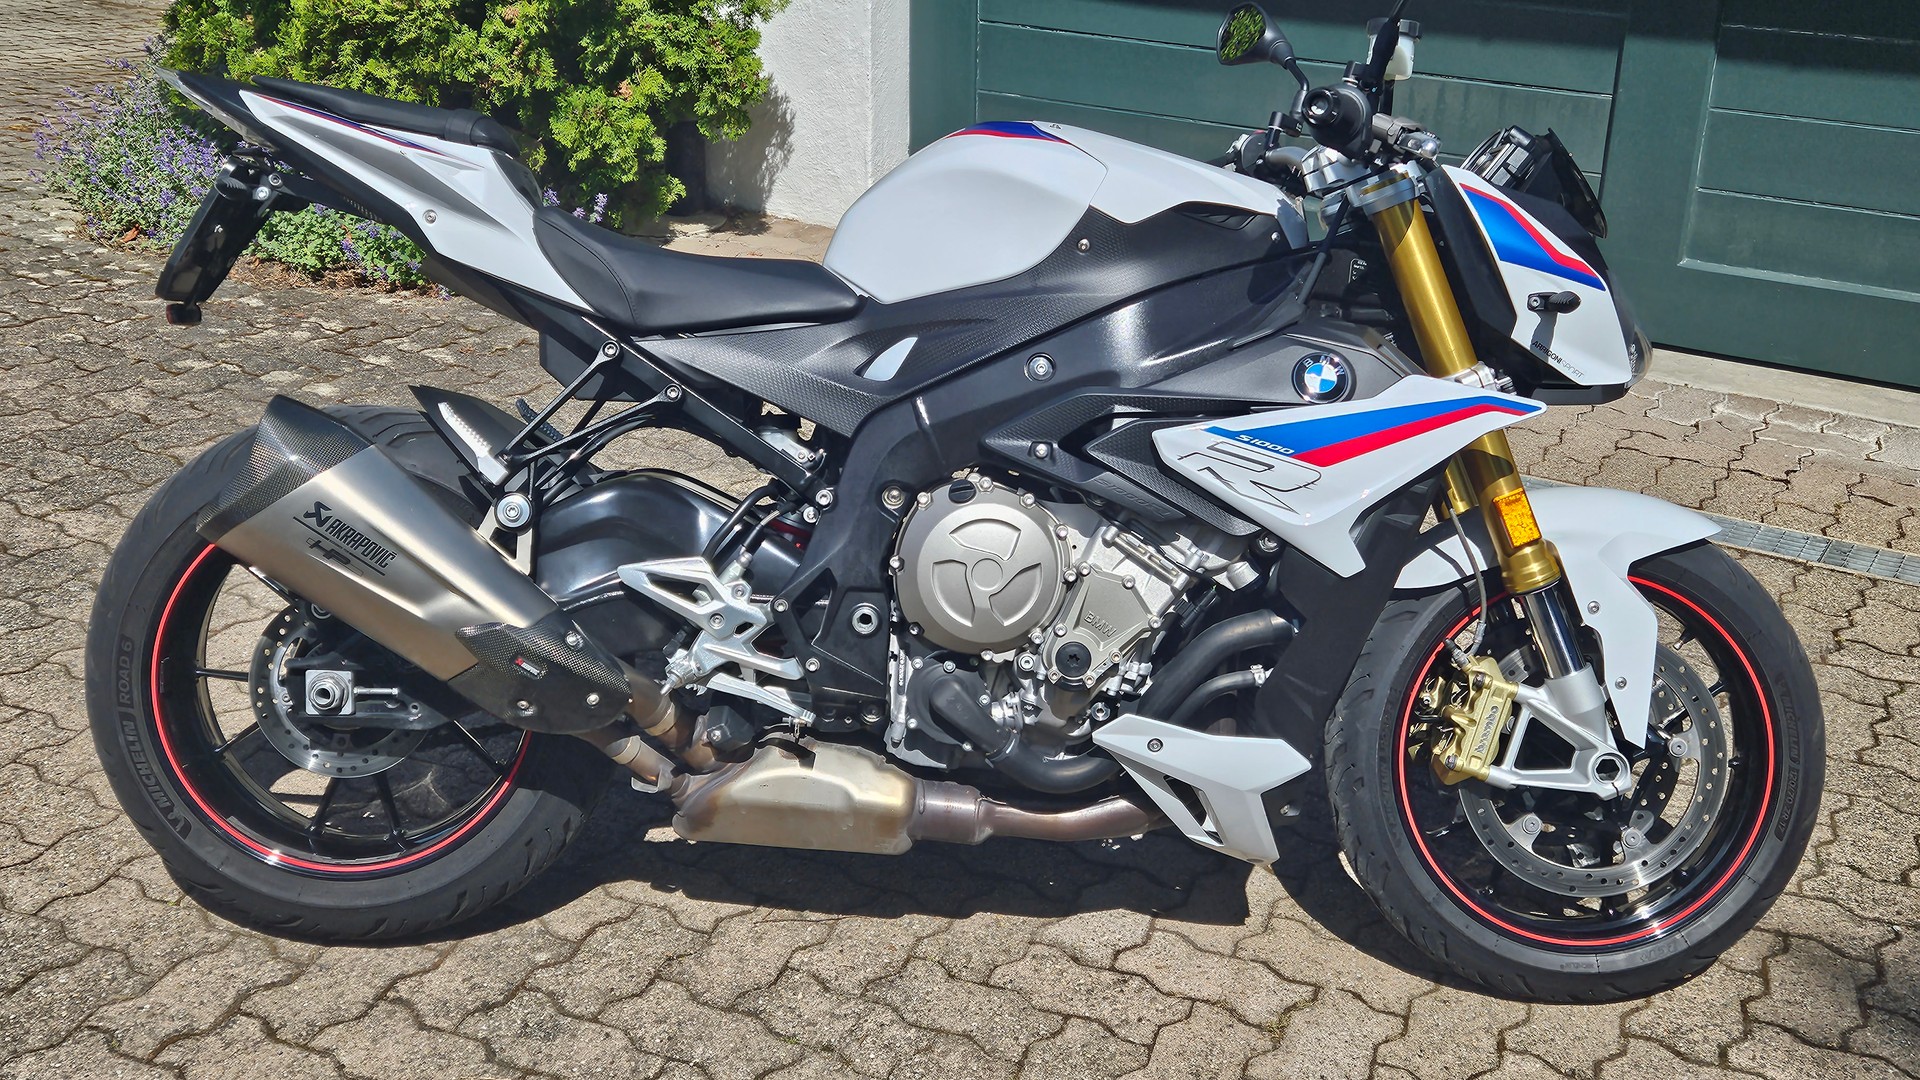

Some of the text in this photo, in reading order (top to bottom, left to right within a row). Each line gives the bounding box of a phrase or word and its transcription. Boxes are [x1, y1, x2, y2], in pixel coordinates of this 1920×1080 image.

[1532, 340, 1563, 364] ARRIGONI
[1235, 434, 1295, 455] S1000
[1083, 610, 1117, 638] BMW
[119, 640, 172, 809] MICHELIN ROAD 6
[1474, 705, 1499, 755] brembo
